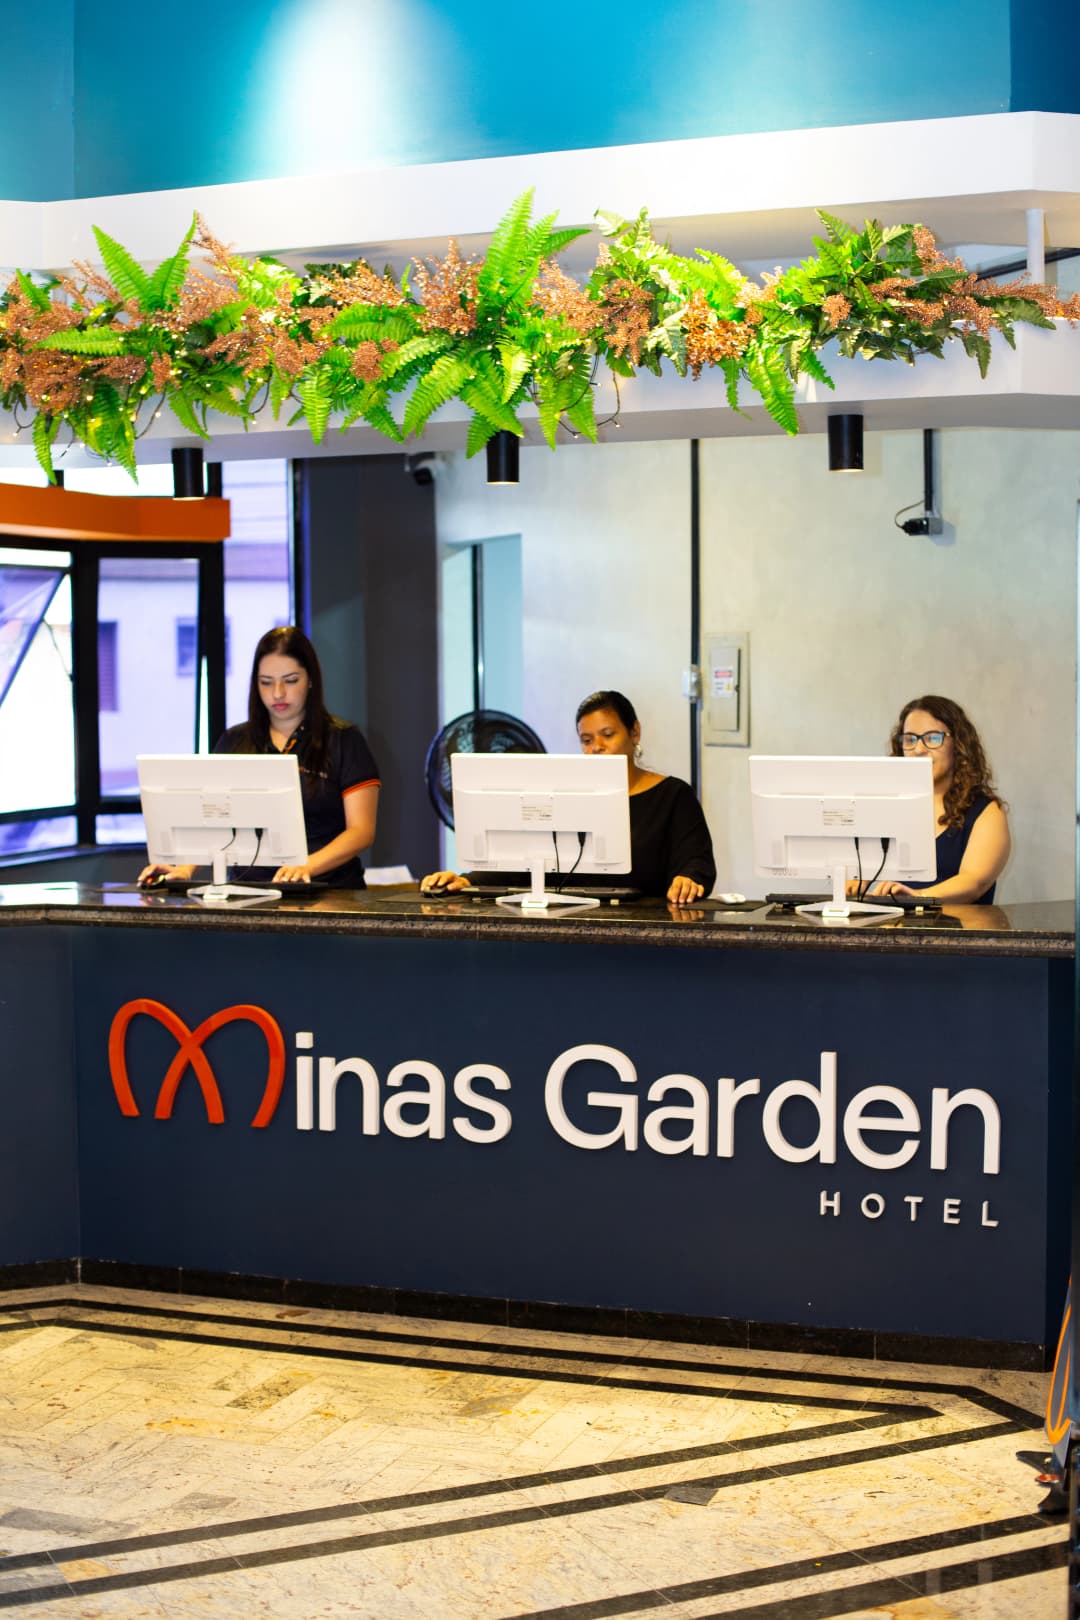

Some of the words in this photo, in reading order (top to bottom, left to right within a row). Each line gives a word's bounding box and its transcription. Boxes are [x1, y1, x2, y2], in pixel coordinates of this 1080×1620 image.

[108, 998, 513, 1145] Minas
[544, 1043, 1001, 1176] Garden
[818, 1190, 1000, 1228] HOTEL
